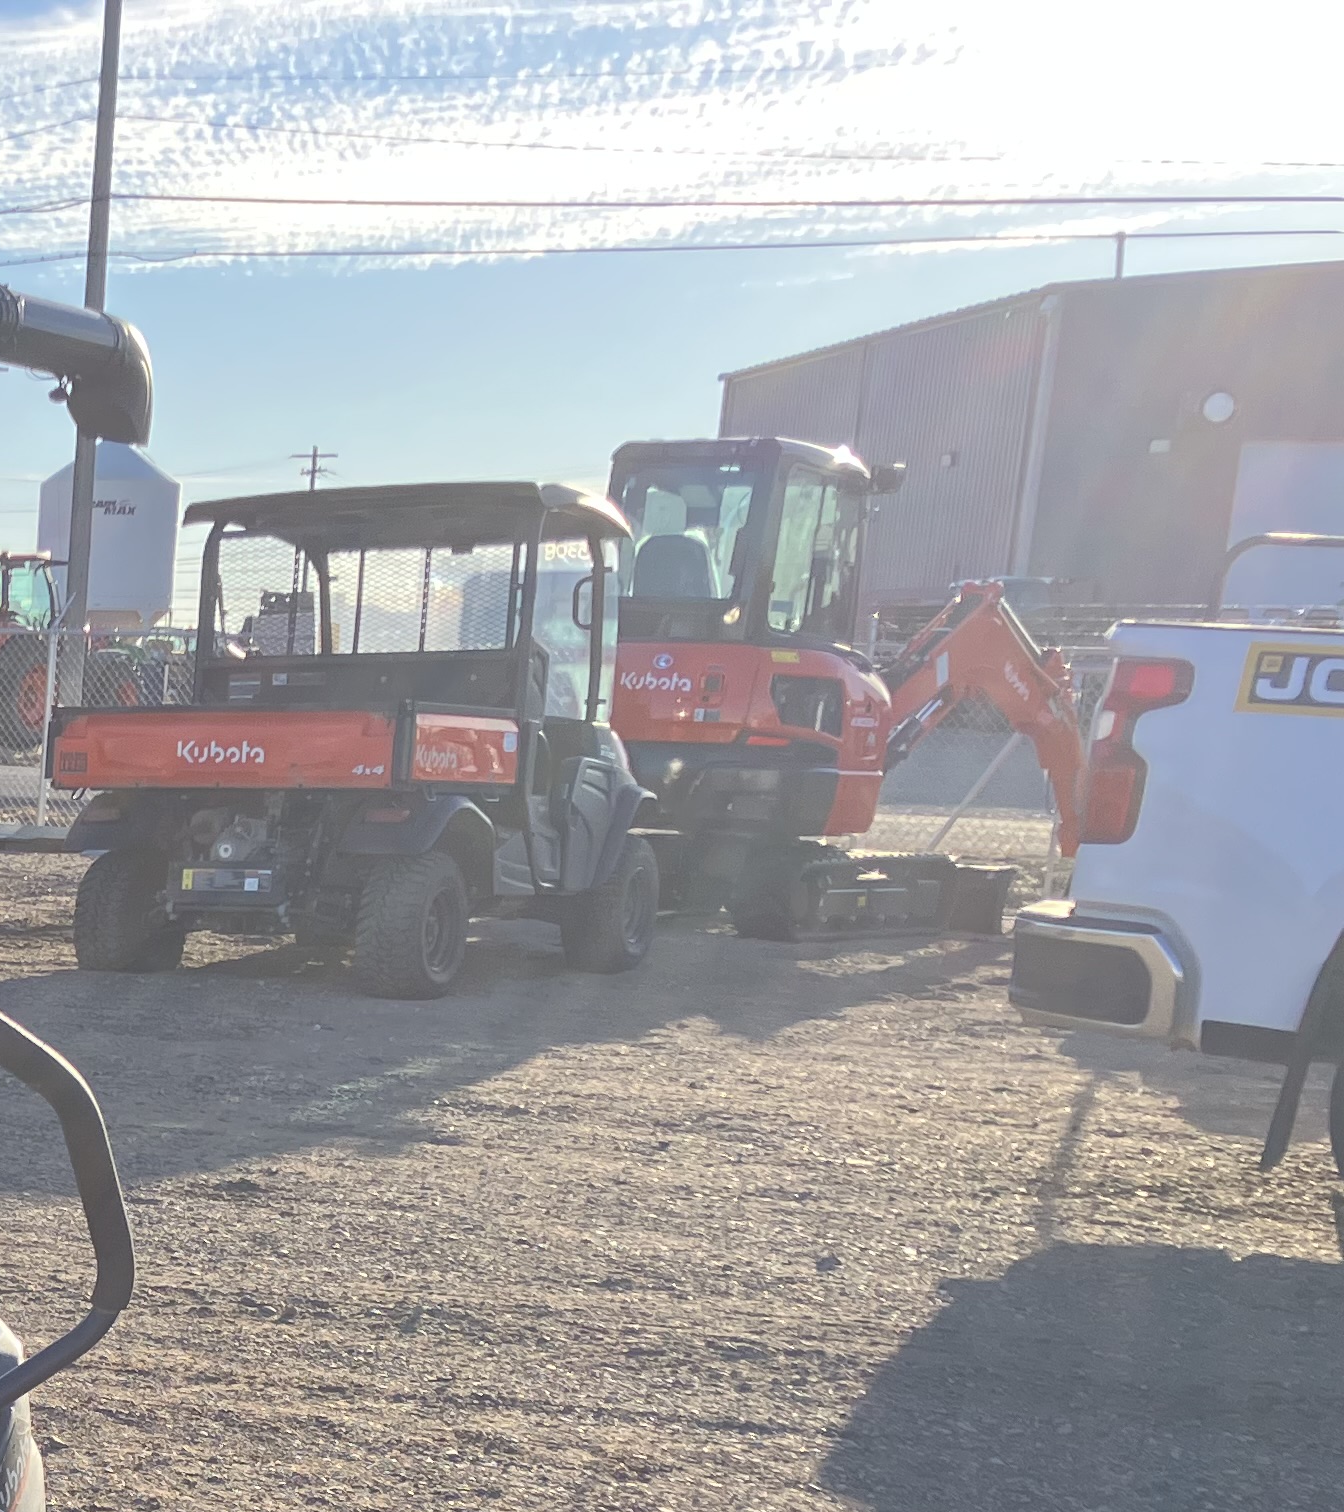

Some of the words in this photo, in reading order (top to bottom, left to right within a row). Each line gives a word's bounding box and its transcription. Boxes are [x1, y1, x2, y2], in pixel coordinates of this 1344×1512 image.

[620, 672, 693, 692] Kubota
[177, 740, 265, 763] Kubota
[415, 744, 458, 769] Kubota
[351, 764, 385, 775] 4x4
